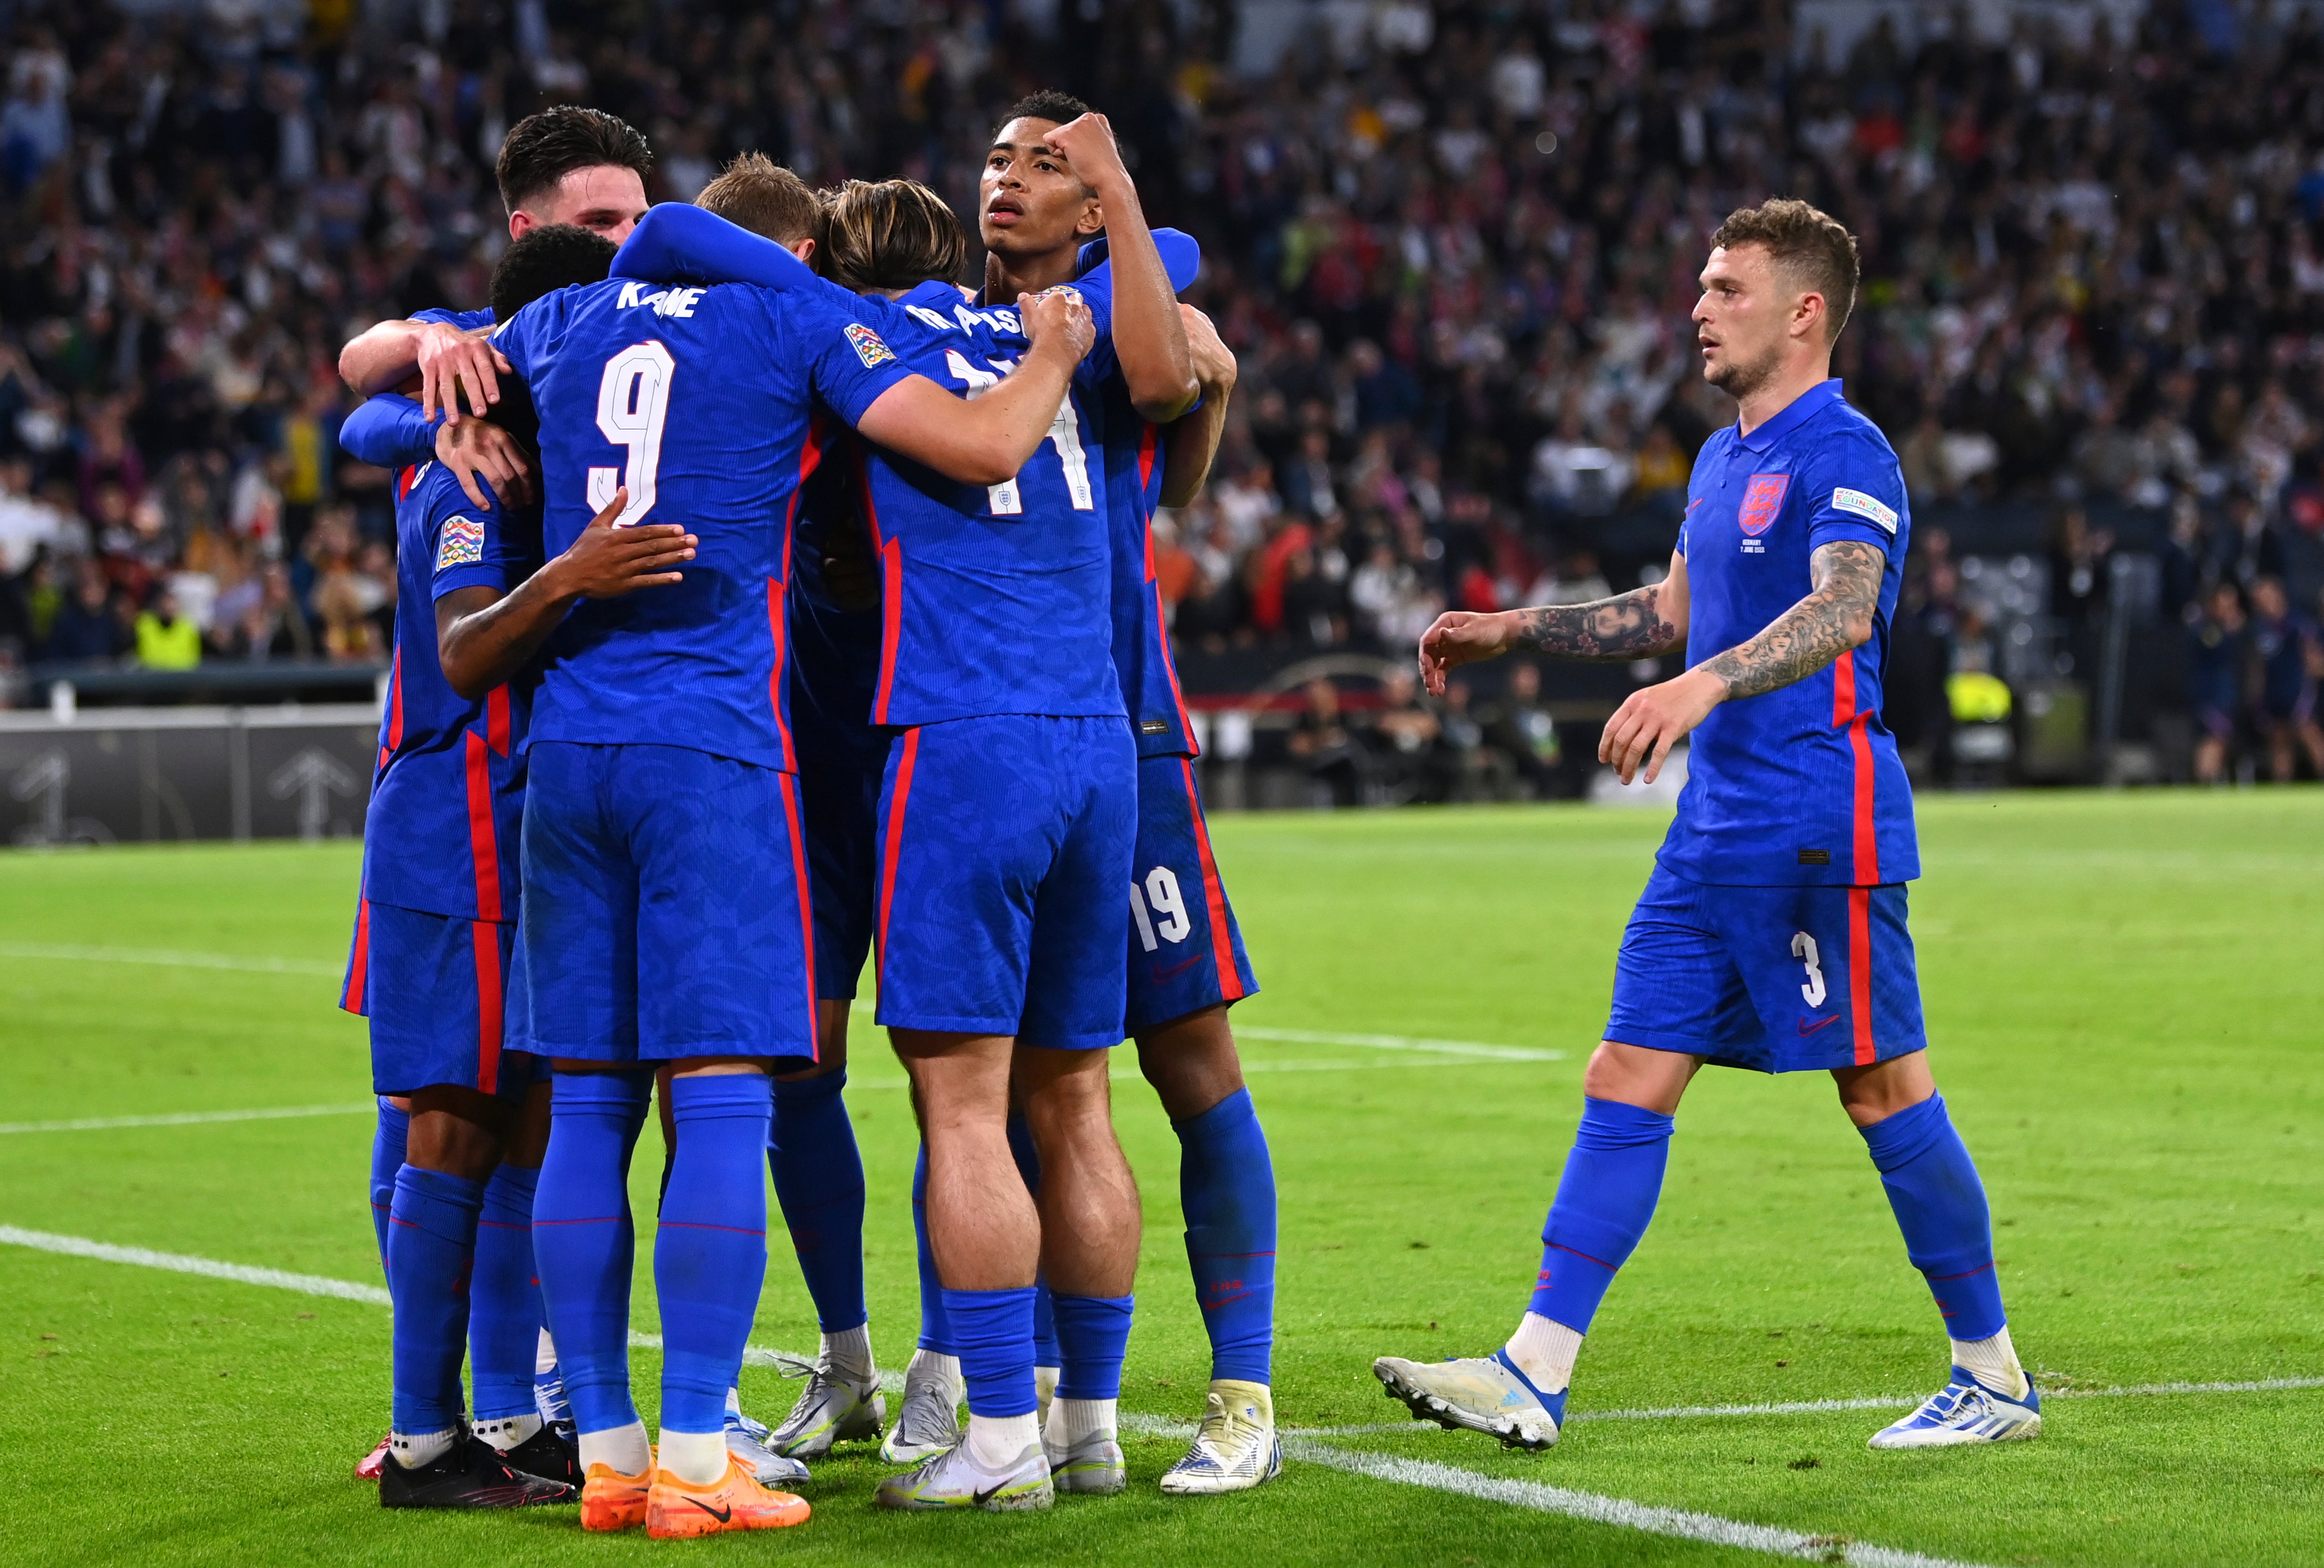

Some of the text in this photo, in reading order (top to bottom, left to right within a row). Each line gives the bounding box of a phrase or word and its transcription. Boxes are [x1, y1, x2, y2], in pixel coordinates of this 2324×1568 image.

[617, 282, 707, 319] KANE
[586, 339, 677, 529] 9
[1835, 494, 1895, 527] FOUNDATION
[1130, 866, 1191, 952] 19
[1791, 931, 1827, 1008] 3
